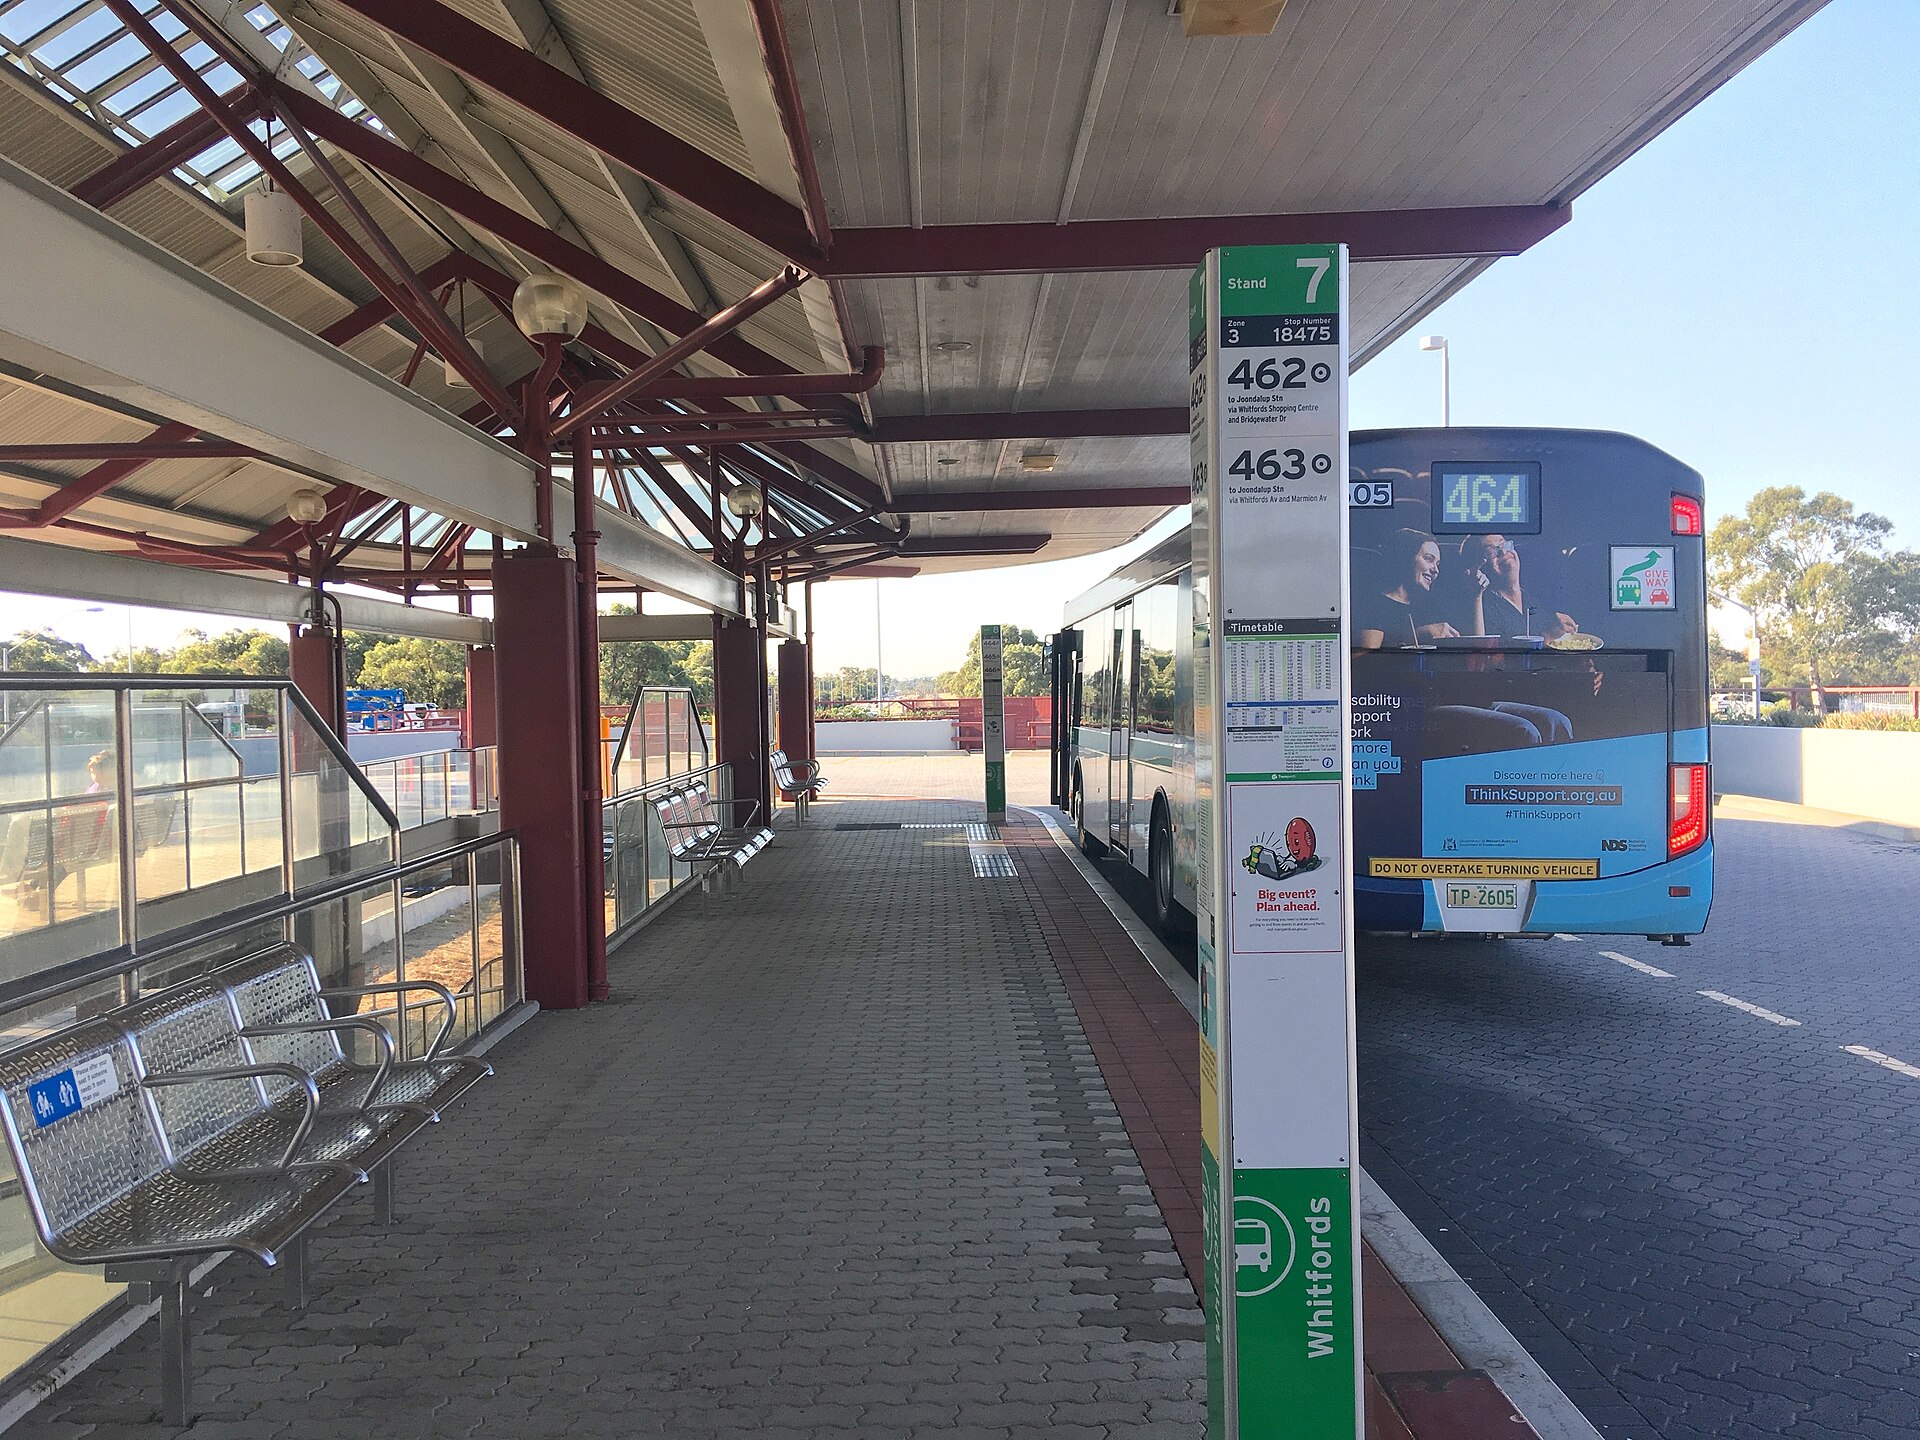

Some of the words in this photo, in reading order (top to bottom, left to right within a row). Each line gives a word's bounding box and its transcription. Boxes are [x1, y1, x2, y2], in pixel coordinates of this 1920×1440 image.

[1228, 277, 1267, 290] Stand
[1297, 258, 1331, 303] 7
[1228, 329, 1240, 344] 3
[1273, 326, 1331, 342] 18475
[1228, 357, 1306, 390] 462
[1237, 395, 1270, 404] Joondalup
[1238, 405, 1267, 413] Whitfords
[1268, 405, 1297, 414] Shopping
[1240, 415, 1278, 424] Bridgewater
[1229, 449, 1306, 481] 463
[1238, 486, 1271, 495] Joondalup
[1349, 484, 1390, 504] 05
[1446, 475, 1522, 522] 464
[1645, 570, 1668, 578] GIVE
[1646, 578, 1668, 587] WAY
[1231, 622, 1284, 633] Timetable
[1351, 711, 1391, 724] pport
[1352, 745, 1388, 753] more
[1374, 761, 1398, 772] you
[1494, 771, 1537, 780] Discover
[1570, 771, 1592, 780] here
[1470, 788, 1616, 803] ThinkSupport.org.au
[1505, 810, 1581, 821] #ThinkSupport
[1602, 840, 1627, 851] NDS
[1375, 864, 1391, 873] DO
[1394, 864, 1418, 874] NOT
[1421, 864, 1483, 874] OVERTAKE
[1487, 865, 1539, 875] TURNING
[1543, 866, 1594, 875] VEHICLE
[1258, 889, 1276, 901] Big
[1279, 889, 1317, 899] event?
[1451, 889, 1470, 905] TP
[1479, 890, 1514, 905] 2605
[1256, 902, 1281, 912] Plan
[1284, 901, 1320, 911] ahead.
[1305, 1197, 1334, 1358] Whitfords
